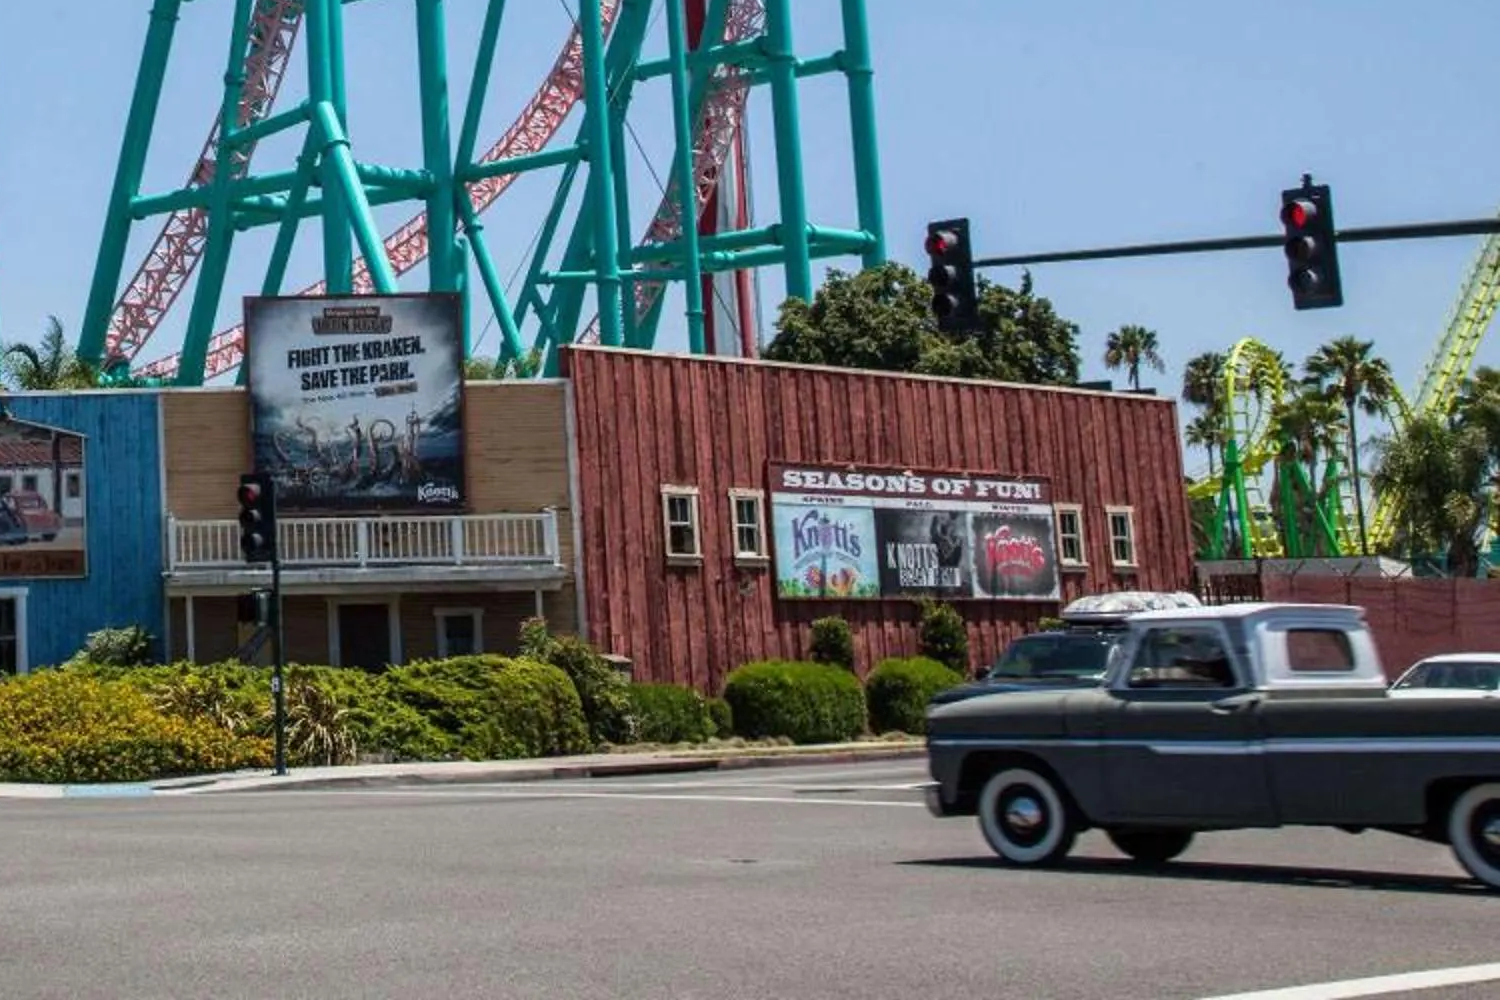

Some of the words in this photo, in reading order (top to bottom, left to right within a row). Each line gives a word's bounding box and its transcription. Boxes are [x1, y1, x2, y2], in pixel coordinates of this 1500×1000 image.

[287, 346, 330, 369] FIGHT
[332, 343, 361, 364] THE
[361, 335, 426, 361] KRAKEN.
[301, 369, 339, 391] SAVE
[341, 366, 369, 386] THE
[370, 360, 415, 383] PARK.
[783, 470, 926, 494] SEASONS
[931, 478, 971, 496] OF
[974, 480, 1041, 499] FUN!
[802, 495, 844, 505] SPRING
